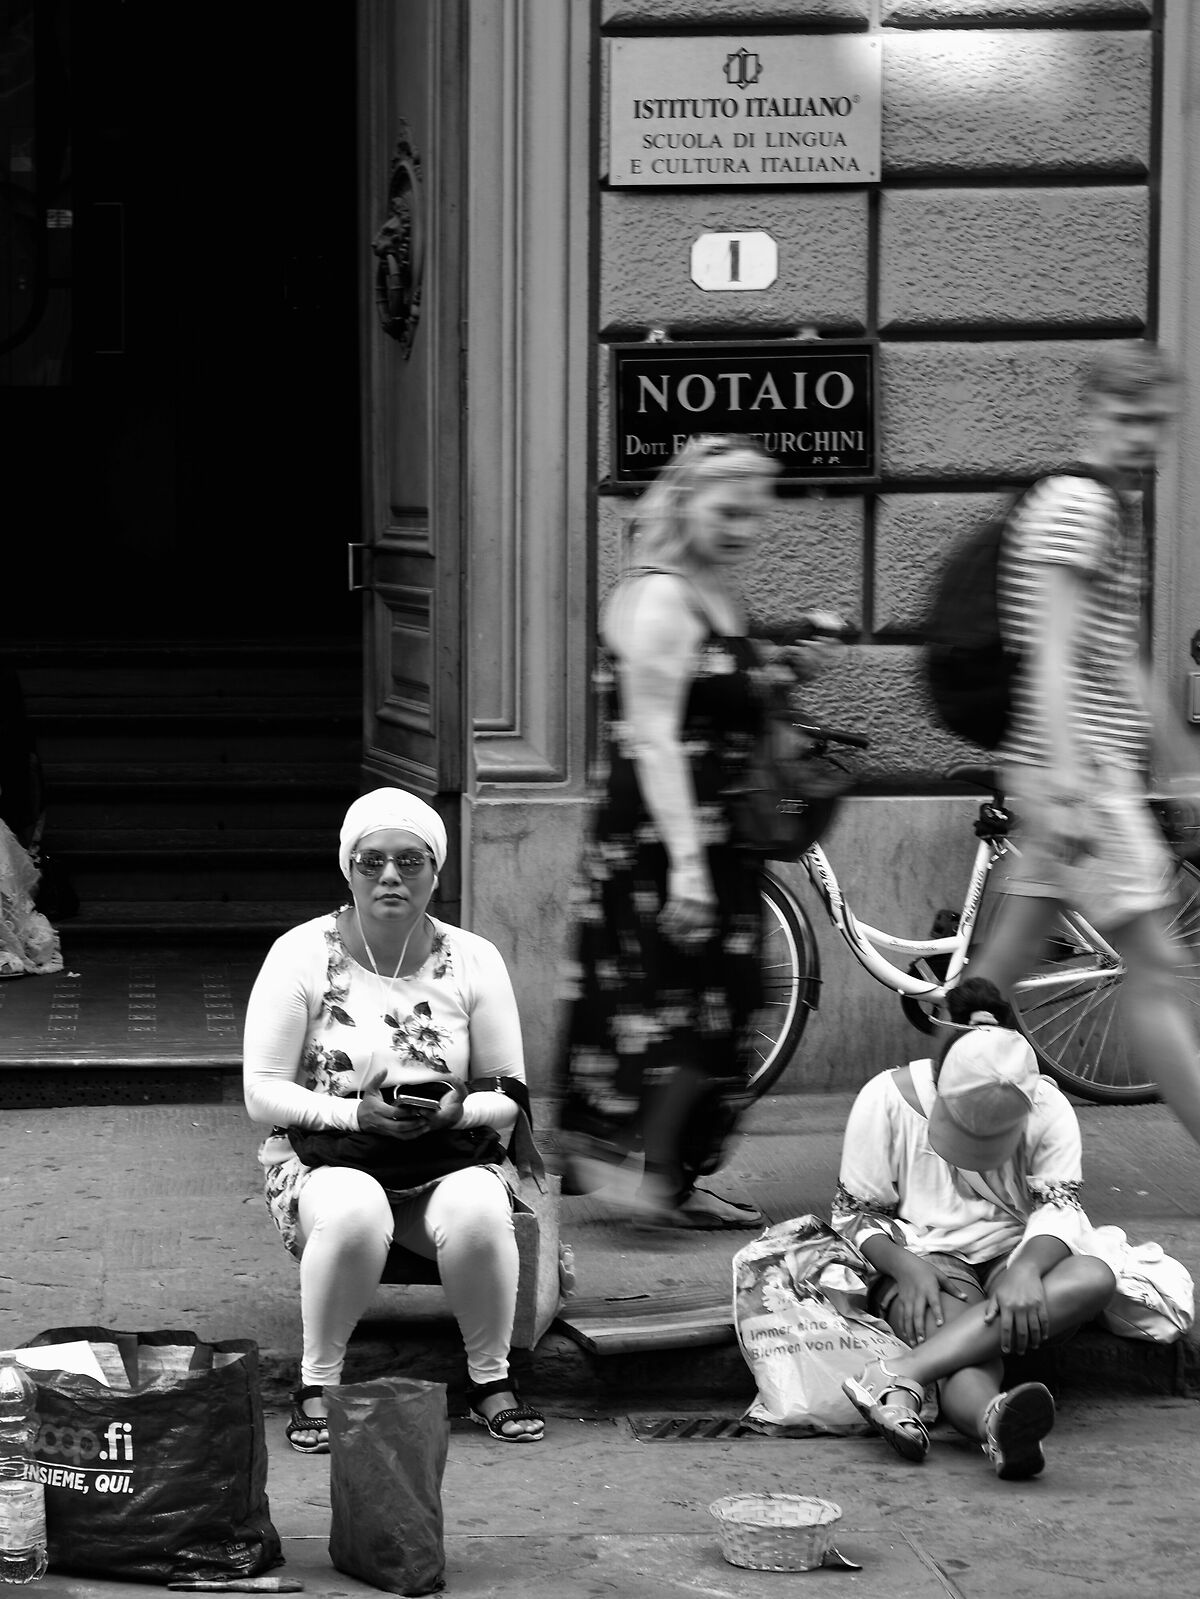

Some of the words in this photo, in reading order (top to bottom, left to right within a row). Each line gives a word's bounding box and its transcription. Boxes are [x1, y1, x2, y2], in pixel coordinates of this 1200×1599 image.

[633, 97, 738, 119] ISTITUTO
[642, 132, 723, 150] SCUOLA
[733, 132, 755, 149] DI
[766, 131, 848, 148] LINGUA
[630, 158, 642, 174] E
[651, 157, 751, 174] CULTURA
[761, 156, 861, 173] ITALIANA
[728, 240, 742, 283] 1
[637, 371, 855, 413] NOTAIO
[746, 430, 865, 452] URCHINI
[751, 1324, 793, 1341] Immer
[750, 1341, 801, 1361] Blumen
[805, 1339, 834, 1351] von
[21, 1463, 90, 1495] INSIEME,
[94, 1473, 135, 1494] QUI.
